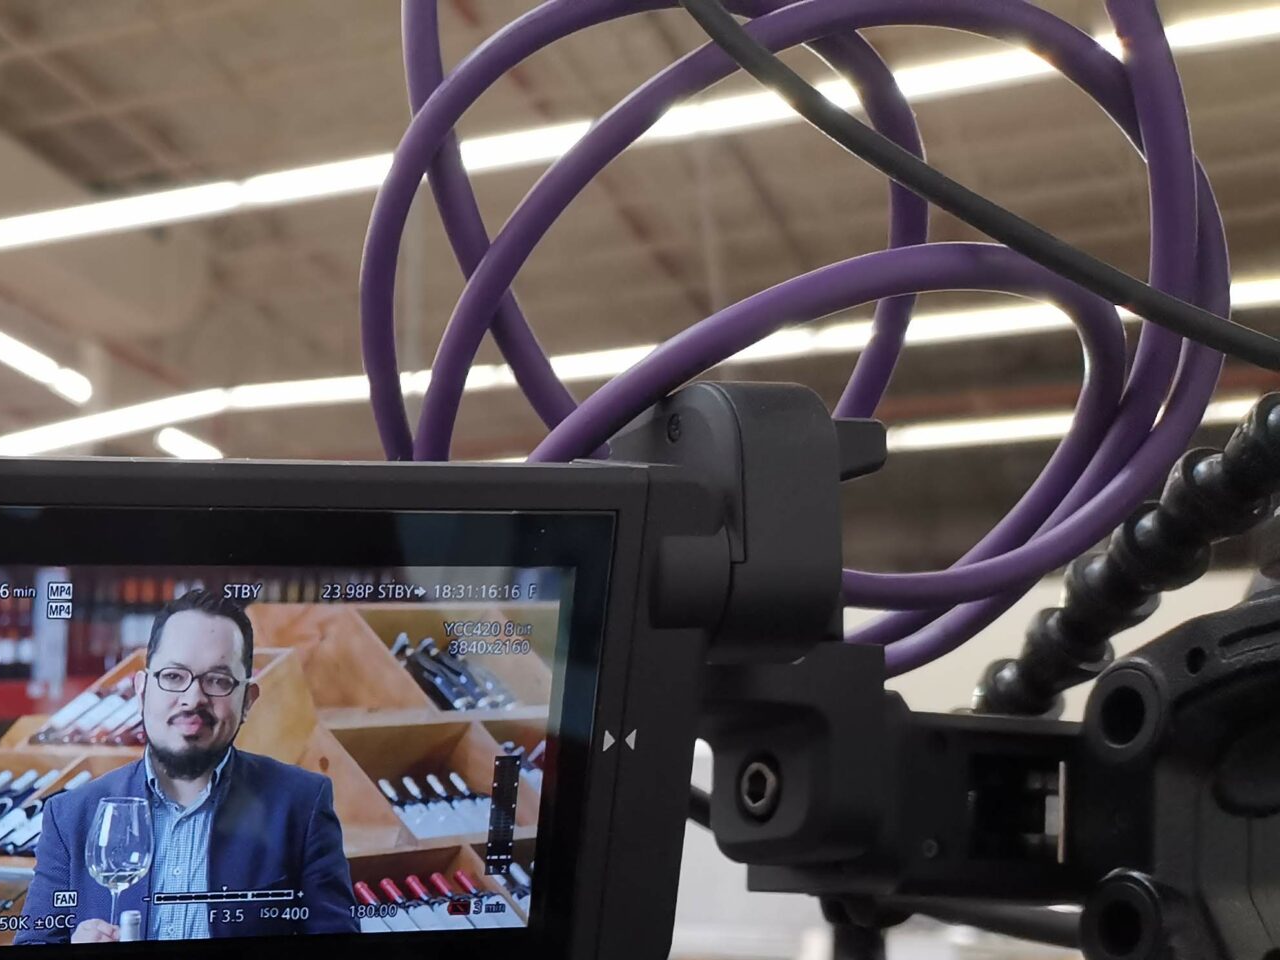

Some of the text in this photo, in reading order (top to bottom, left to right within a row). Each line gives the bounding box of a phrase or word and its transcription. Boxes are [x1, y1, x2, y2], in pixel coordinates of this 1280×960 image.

[13, 587, 36, 598] min
[49, 585, 72, 598] MP4
[223, 585, 262, 599] STBY
[322, 585, 415, 599] 23.98P STBY
[433, 584, 520, 599] 18:31:16:16
[48, 604, 72, 617] MP4
[444, 622, 500, 637] YCC420
[504, 622, 513, 636] 8
[449, 640, 530, 654] 3840x2160
[55, 893, 76, 905] FAN
[260, 906, 310, 920] ISO 400
[349, 904, 398, 918] 180.00
[472, 902, 507, 914] 3 min
[209, 909, 245, 923] F 3.5
